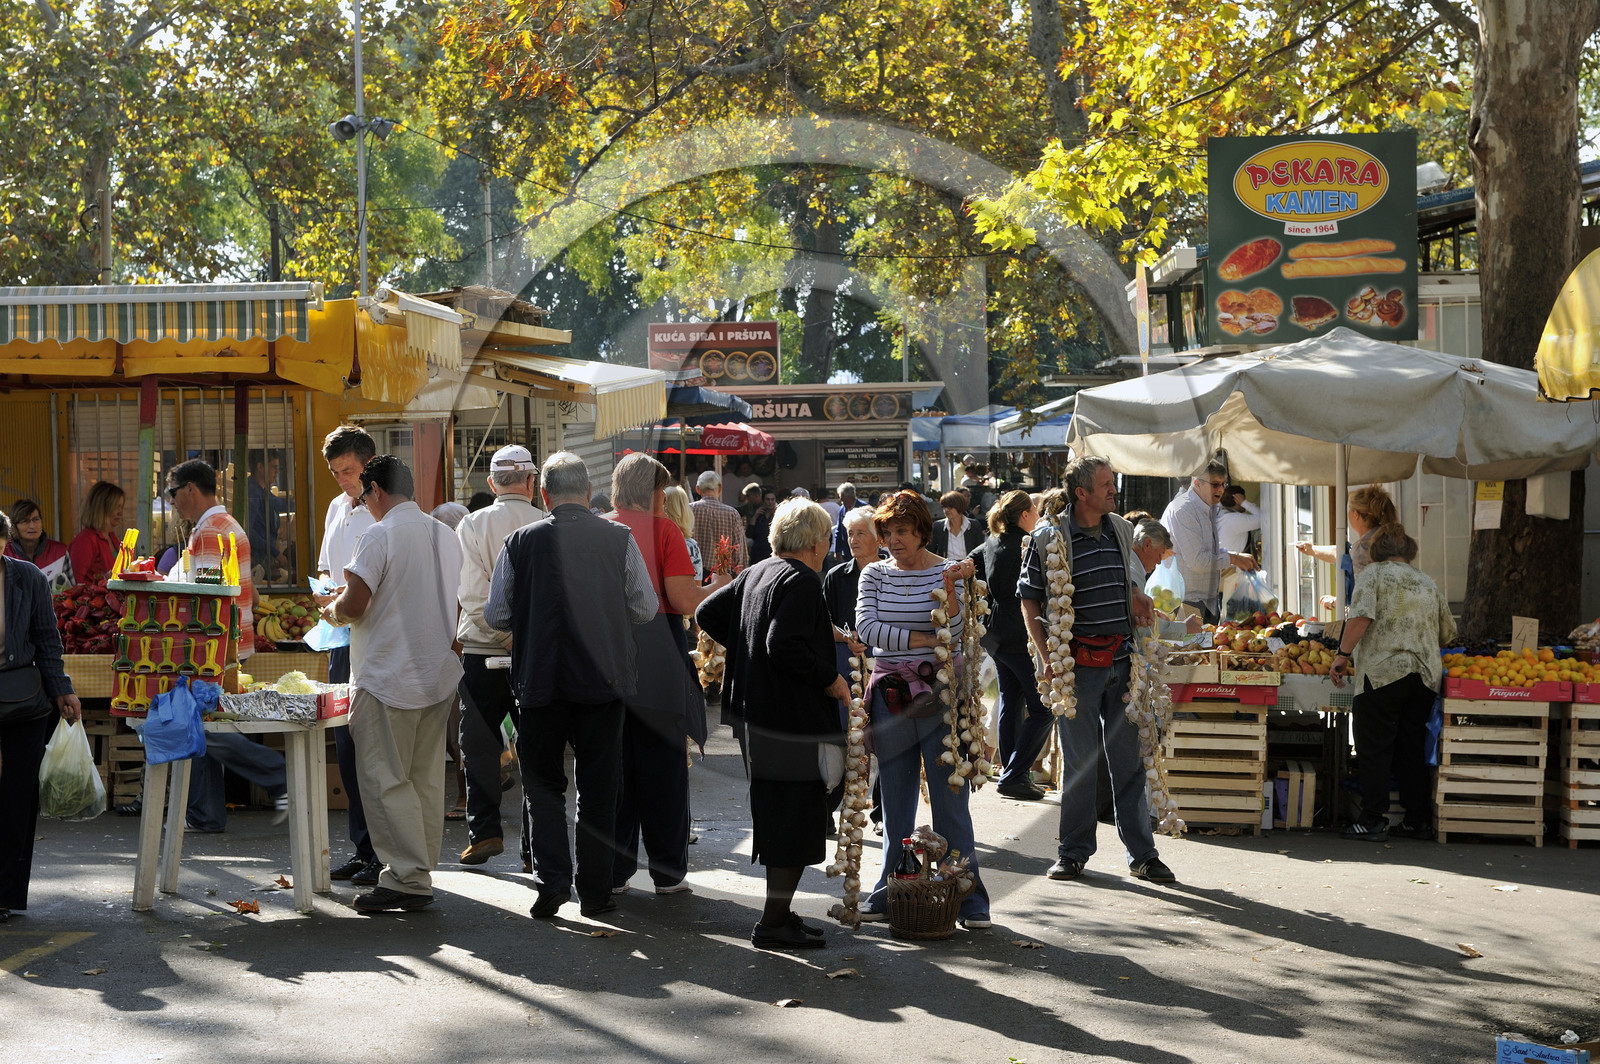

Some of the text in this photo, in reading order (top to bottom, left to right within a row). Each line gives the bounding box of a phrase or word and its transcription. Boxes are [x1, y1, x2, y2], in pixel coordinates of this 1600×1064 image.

[1245, 157, 1381, 190] PEKARA
[1265, 190, 1358, 214] KAMEN
[1287, 224, 1335, 234] since 1964
[654, 328, 772, 342] KUĆA SIRA I PRŠUTA
[751, 399, 812, 418] RŠUTA
[1196, 687, 1237, 696] Fragaria
[1488, 688, 1531, 697] Fragaria
